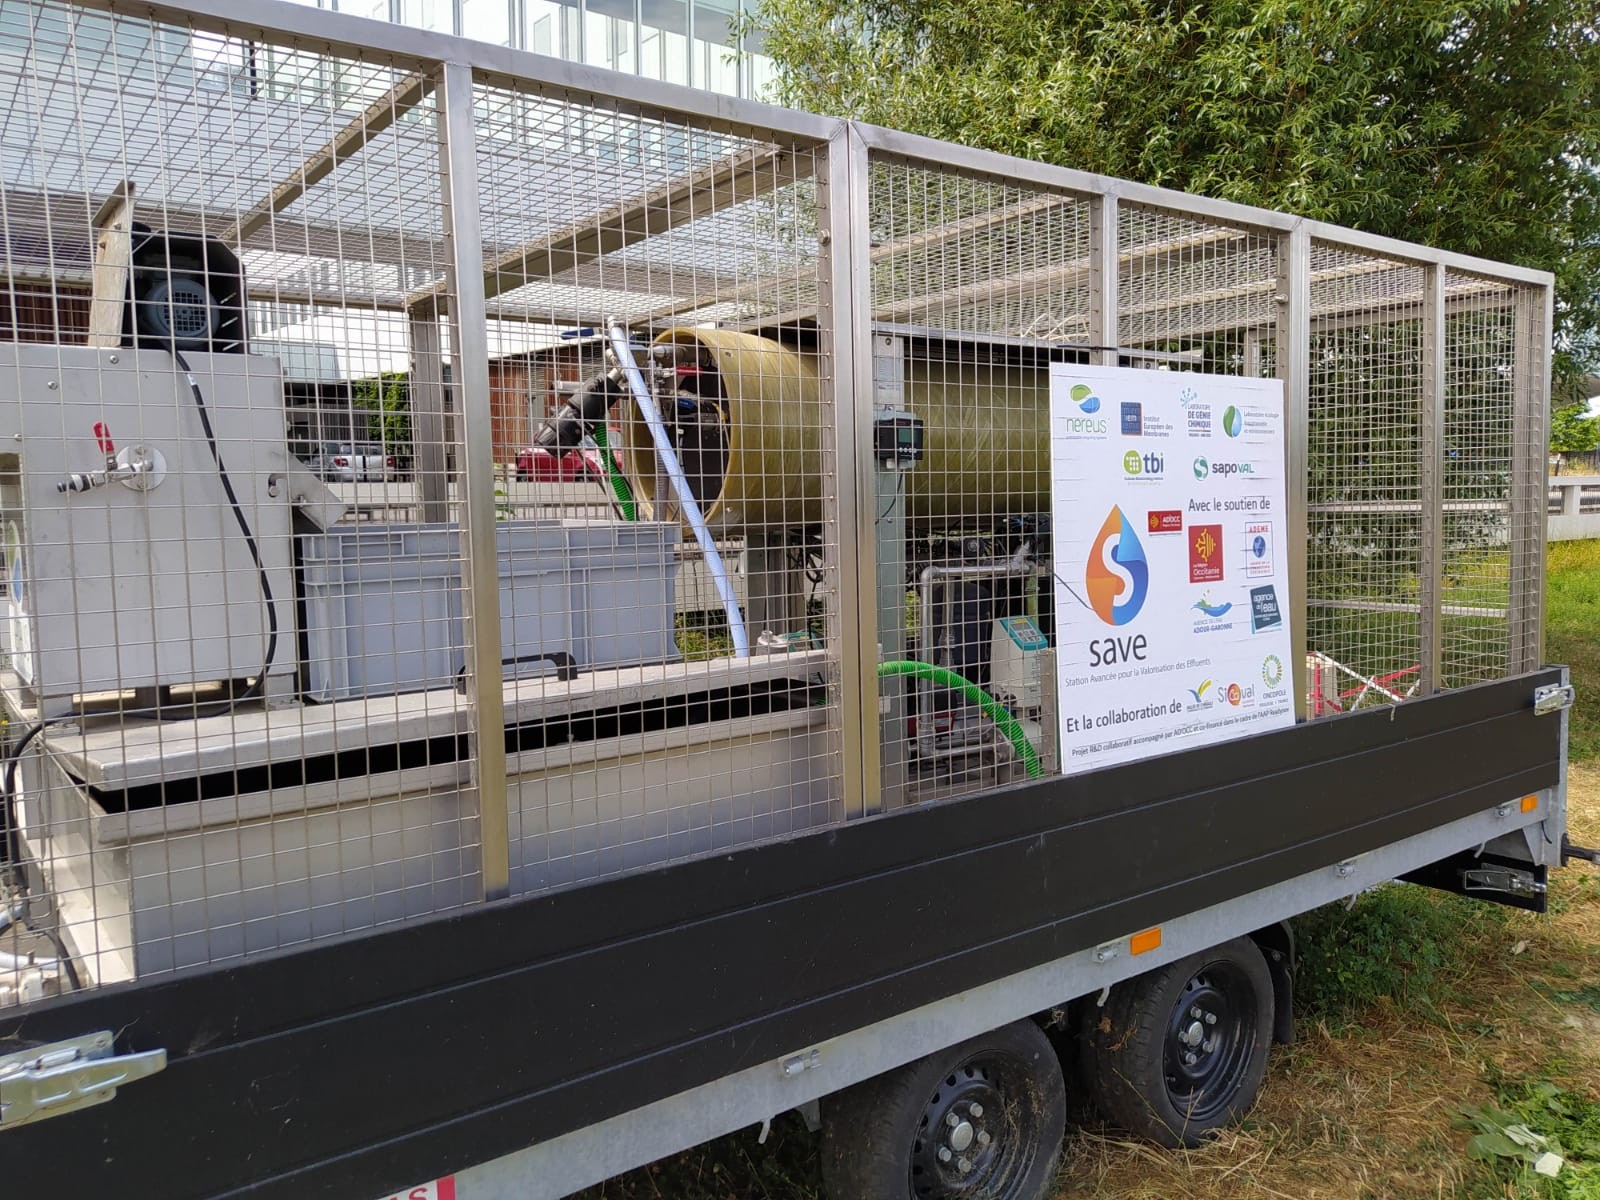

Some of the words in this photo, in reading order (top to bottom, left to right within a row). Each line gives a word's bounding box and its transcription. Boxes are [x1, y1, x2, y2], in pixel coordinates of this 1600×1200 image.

[1066, 418, 1107, 434] nereus
[1143, 451, 1164, 474] tbi
[1188, 498, 1211, 512] Avec
[1213, 497, 1222, 511] le
[1224, 497, 1258, 511] soutien
[1260, 496, 1271, 510] de
[1090, 634, 1147, 667] save
[1065, 677, 1089, 687] Station
[1090, 672, 1117, 683] Avancée
[1118, 670, 1133, 680] pour
[1134, 668, 1140, 677] la
[1140, 662, 1175, 677] Valorisation
[1175, 661, 1186, 670] des
[1066, 717, 1080, 733] Et
[1082, 714, 1093, 730] la
[1096, 703, 1167, 728] collaboration
[1169, 698, 1183, 714] de
[1071, 748, 1089, 757] Projet
[1089, 744, 1103, 754] R&D
[1103, 737, 1133, 752] collaboratif
